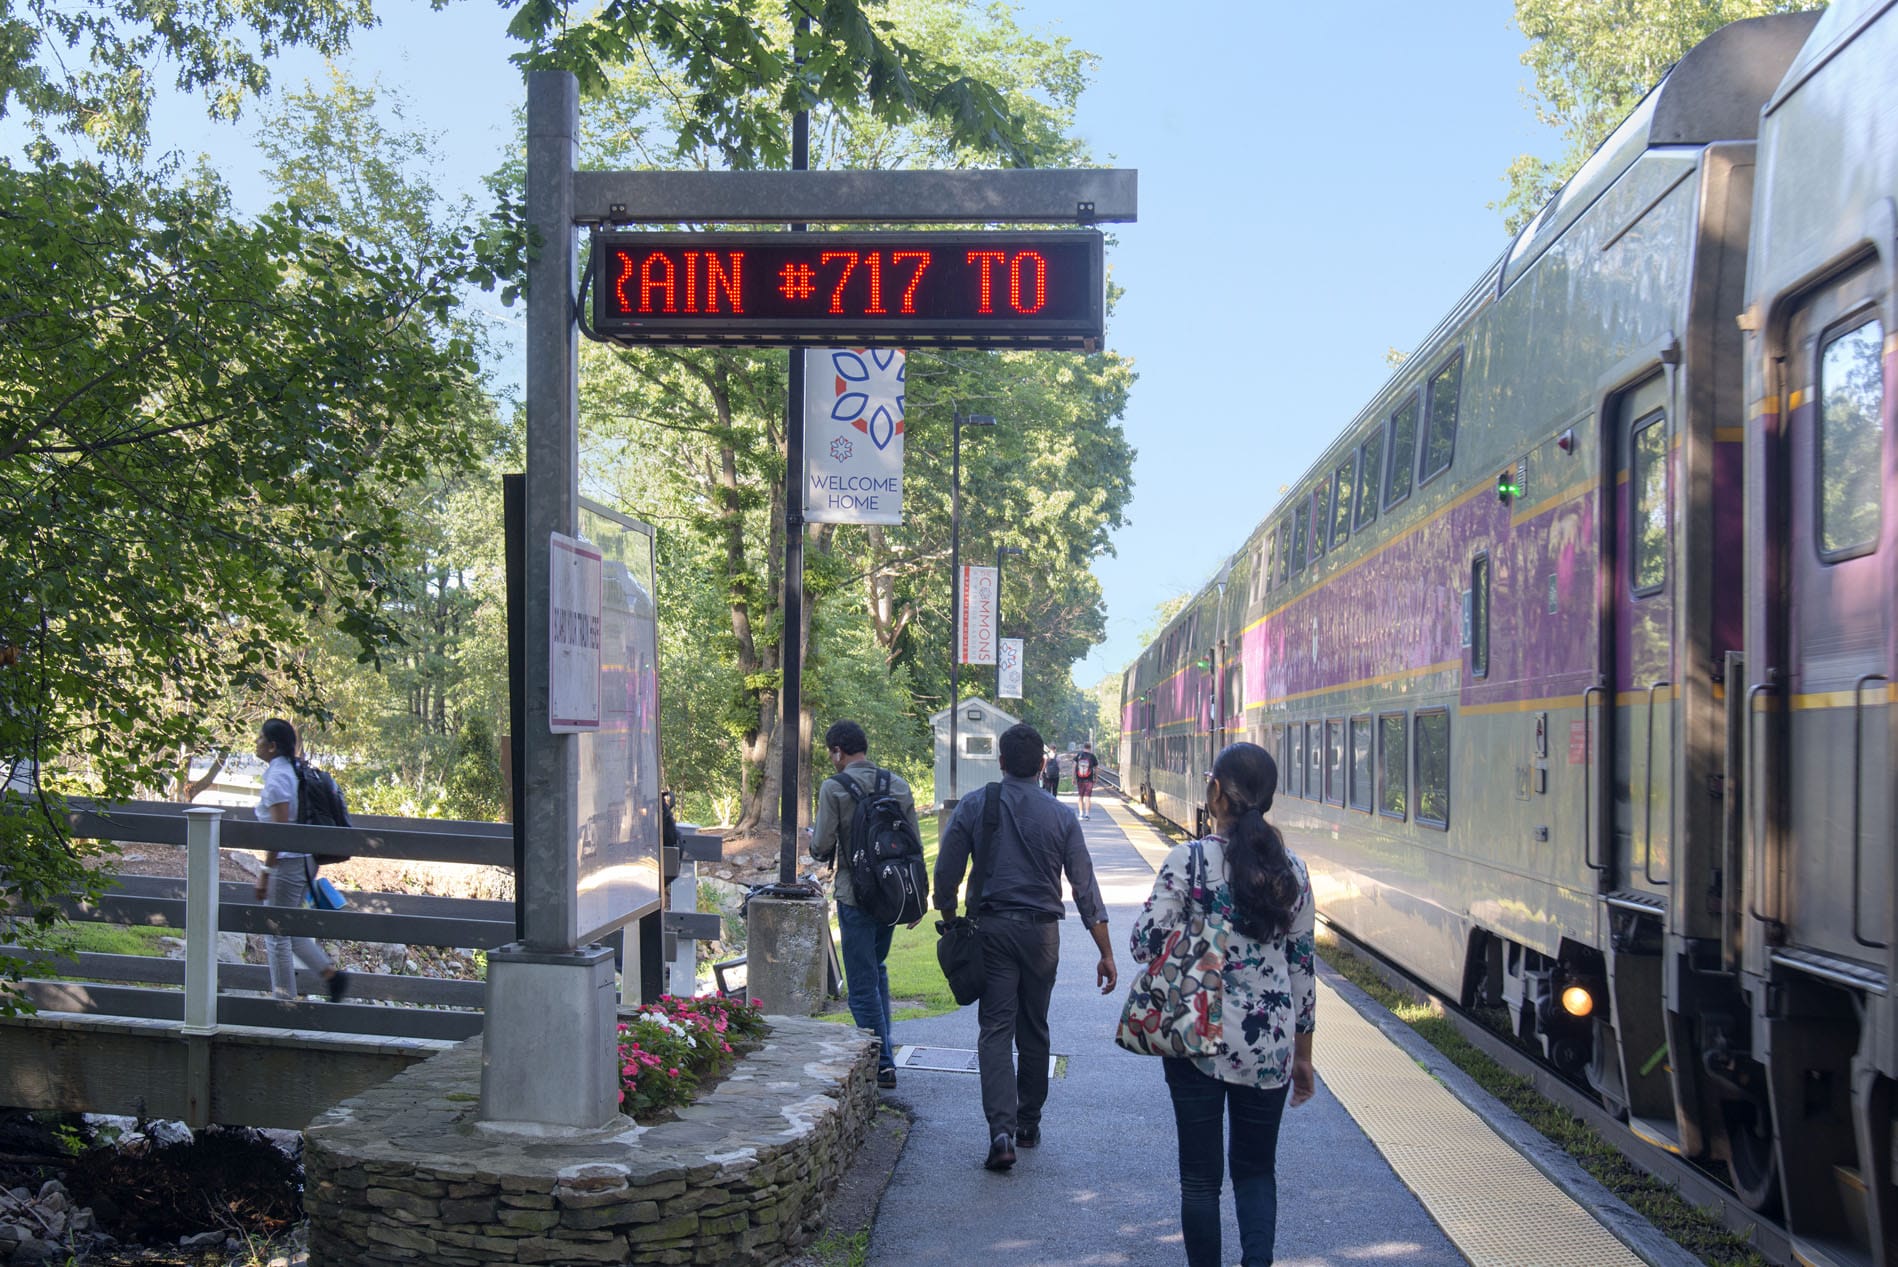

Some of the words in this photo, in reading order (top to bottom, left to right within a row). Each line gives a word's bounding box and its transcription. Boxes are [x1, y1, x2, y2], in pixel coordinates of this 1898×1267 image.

[778, 251, 932, 314] #717
[967, 251, 1047, 314] TO
[811, 475, 897, 492] WELCOME
[829, 495, 879, 510] HOME
[979, 577, 992, 661] COMMONS
